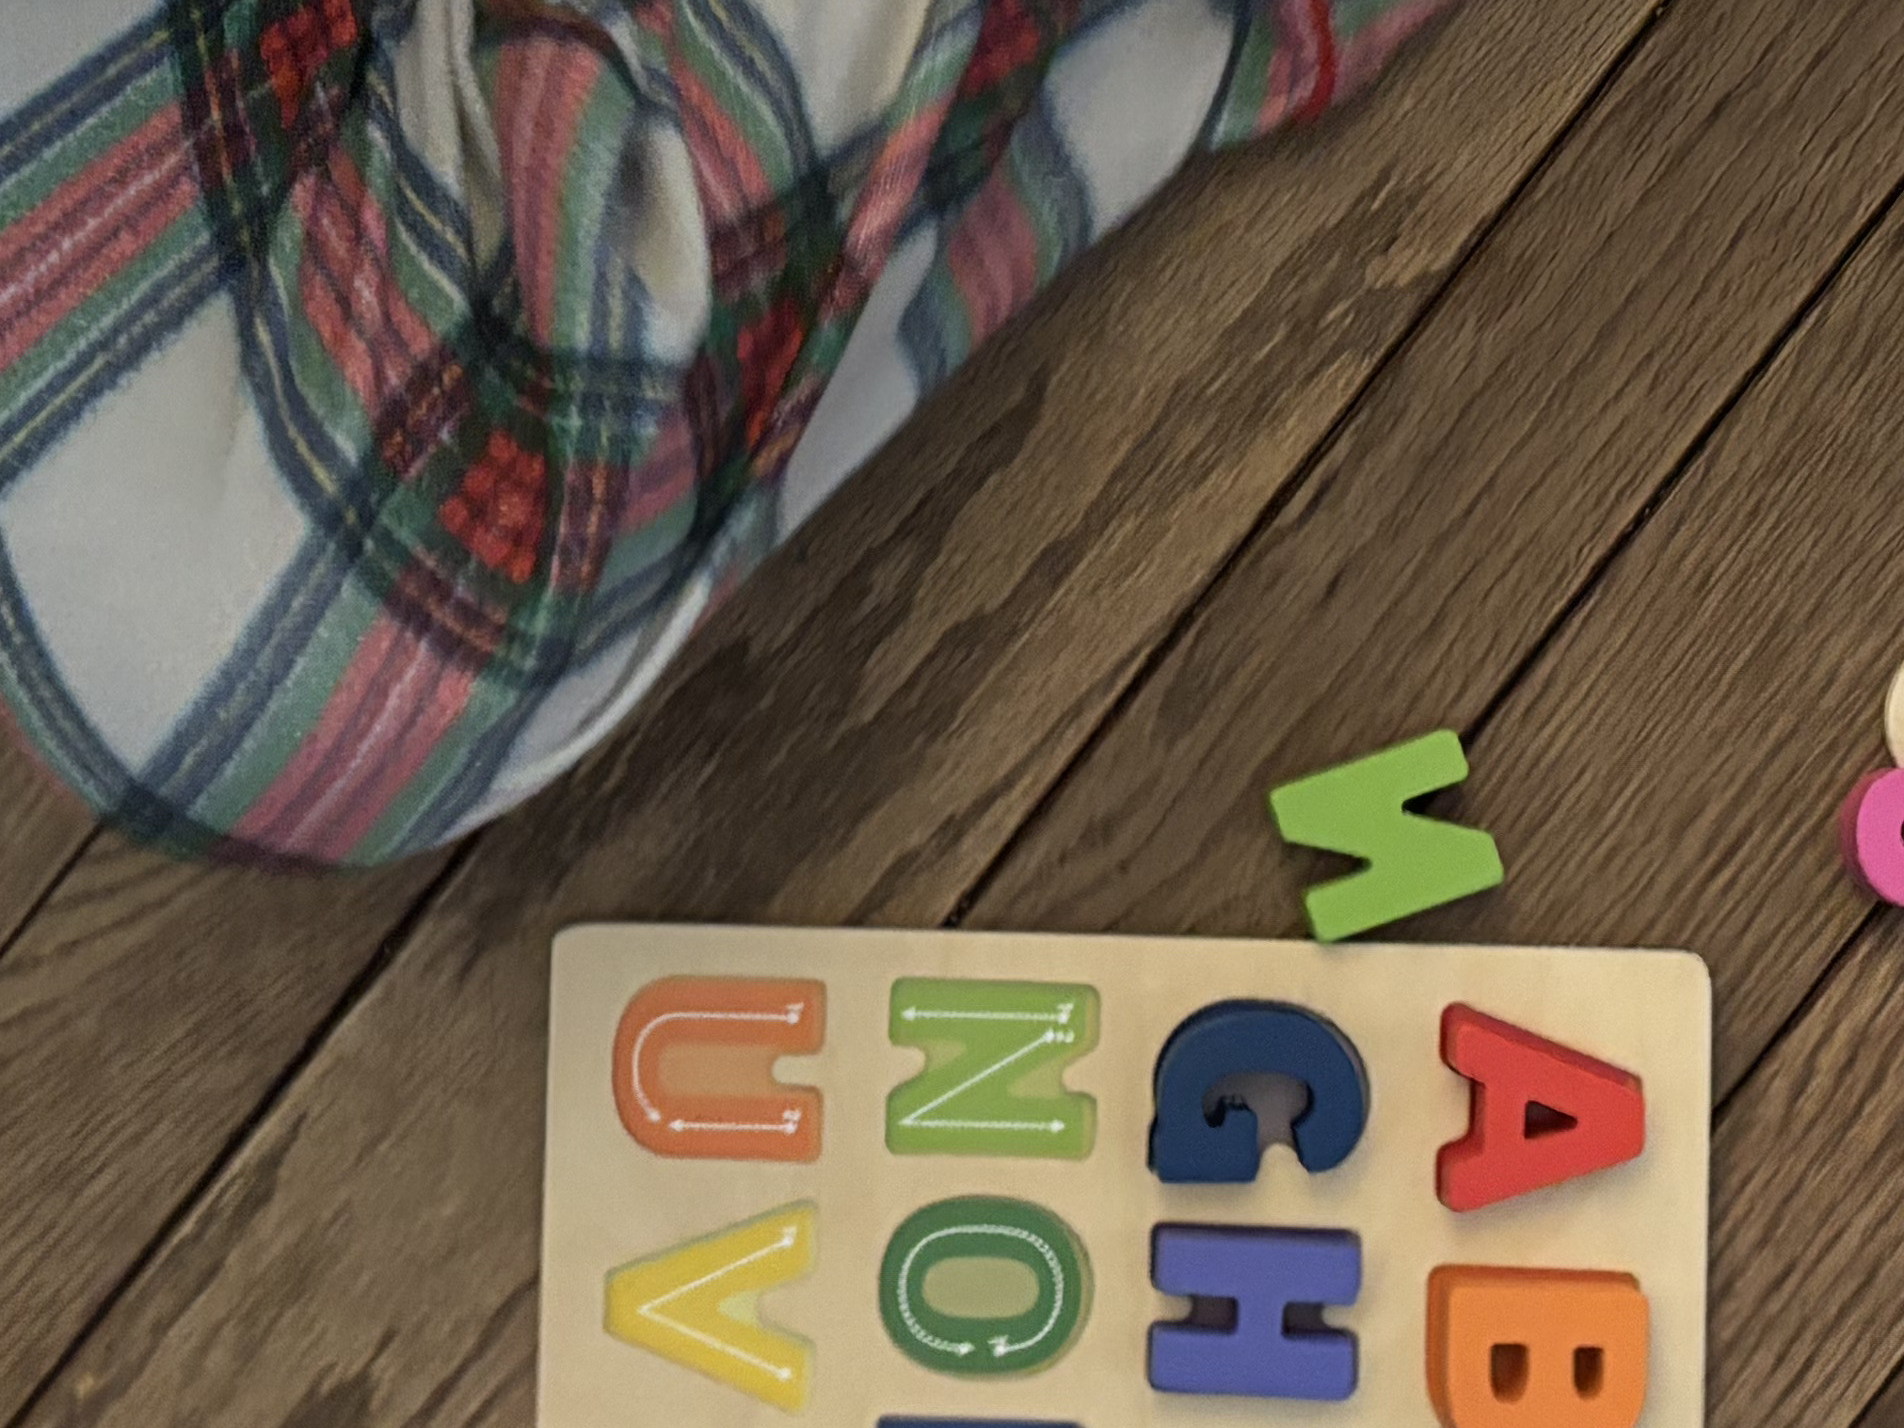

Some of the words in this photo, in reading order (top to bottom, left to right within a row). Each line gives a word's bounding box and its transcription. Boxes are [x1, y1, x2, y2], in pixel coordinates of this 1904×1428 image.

[612, 973, 828, 1161] U
[885, 976, 1101, 1158] N
[1147, 998, 1371, 1184] G
[1437, 1001, 1646, 1213] A
[604, 1202, 819, 1409] V
[880, 1195, 1089, 1377] O
[1146, 1222, 1364, 1401] H
